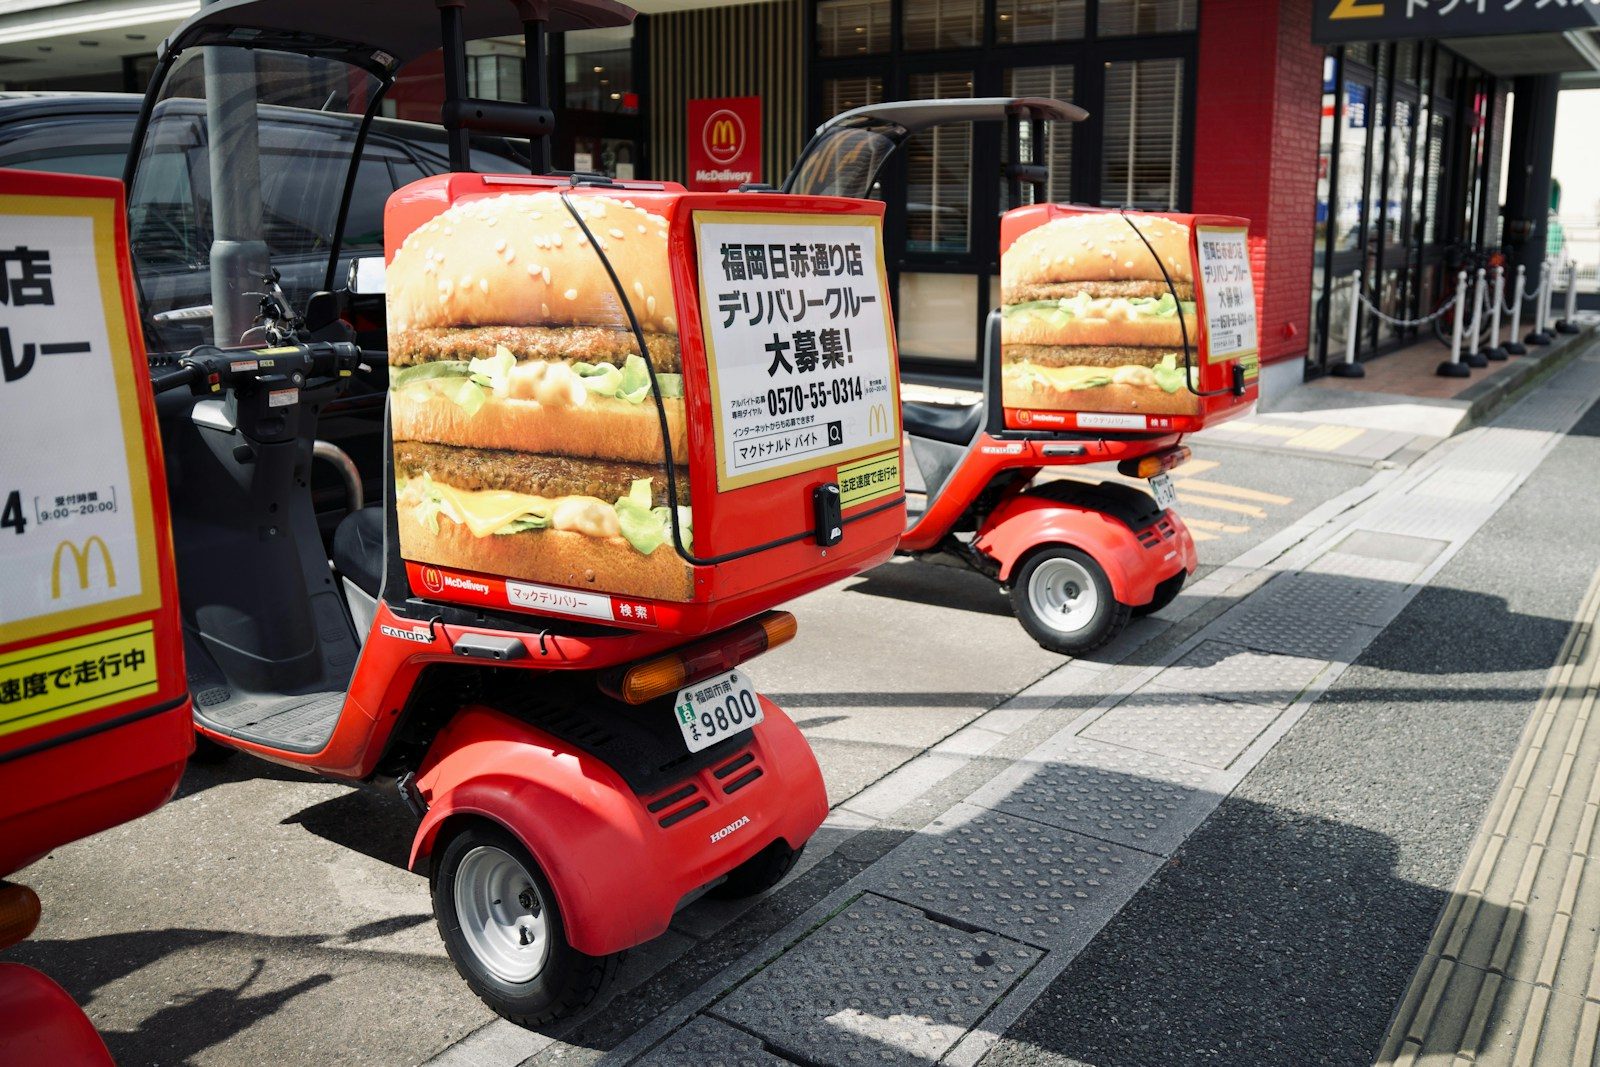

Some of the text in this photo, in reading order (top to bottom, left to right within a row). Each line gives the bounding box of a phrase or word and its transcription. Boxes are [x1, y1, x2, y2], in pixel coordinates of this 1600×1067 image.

[695, 169, 752, 183] McDelivery
[720, 242, 864, 281] 福岡日赤通り店
[718, 286, 876, 329] デリバリークルー
[765, 328, 853, 377] 大募集!
[731, 395, 766, 408] アルバイト応募
[767, 375, 863, 416] 0570-55-0314
[732, 407, 762, 419] 専用ダイヤル
[733, 415, 815, 438] インターネットからも応募できます
[739, 432, 818, 459] マクドナルド バイト
[841, 465, 897, 493] 法定速度で走行中
[55, 491, 98, 507] 受付時間
[0, 490, 26, 534] 4
[444, 576, 490, 595] McDelivery
[512, 587, 588, 608] マックデリバリー
[619, 603, 648, 619] 検索
[695, 680, 732, 704] 福岡市南
[701, 689, 757, 737] 9800
[710, 815, 750, 843] HONDA
